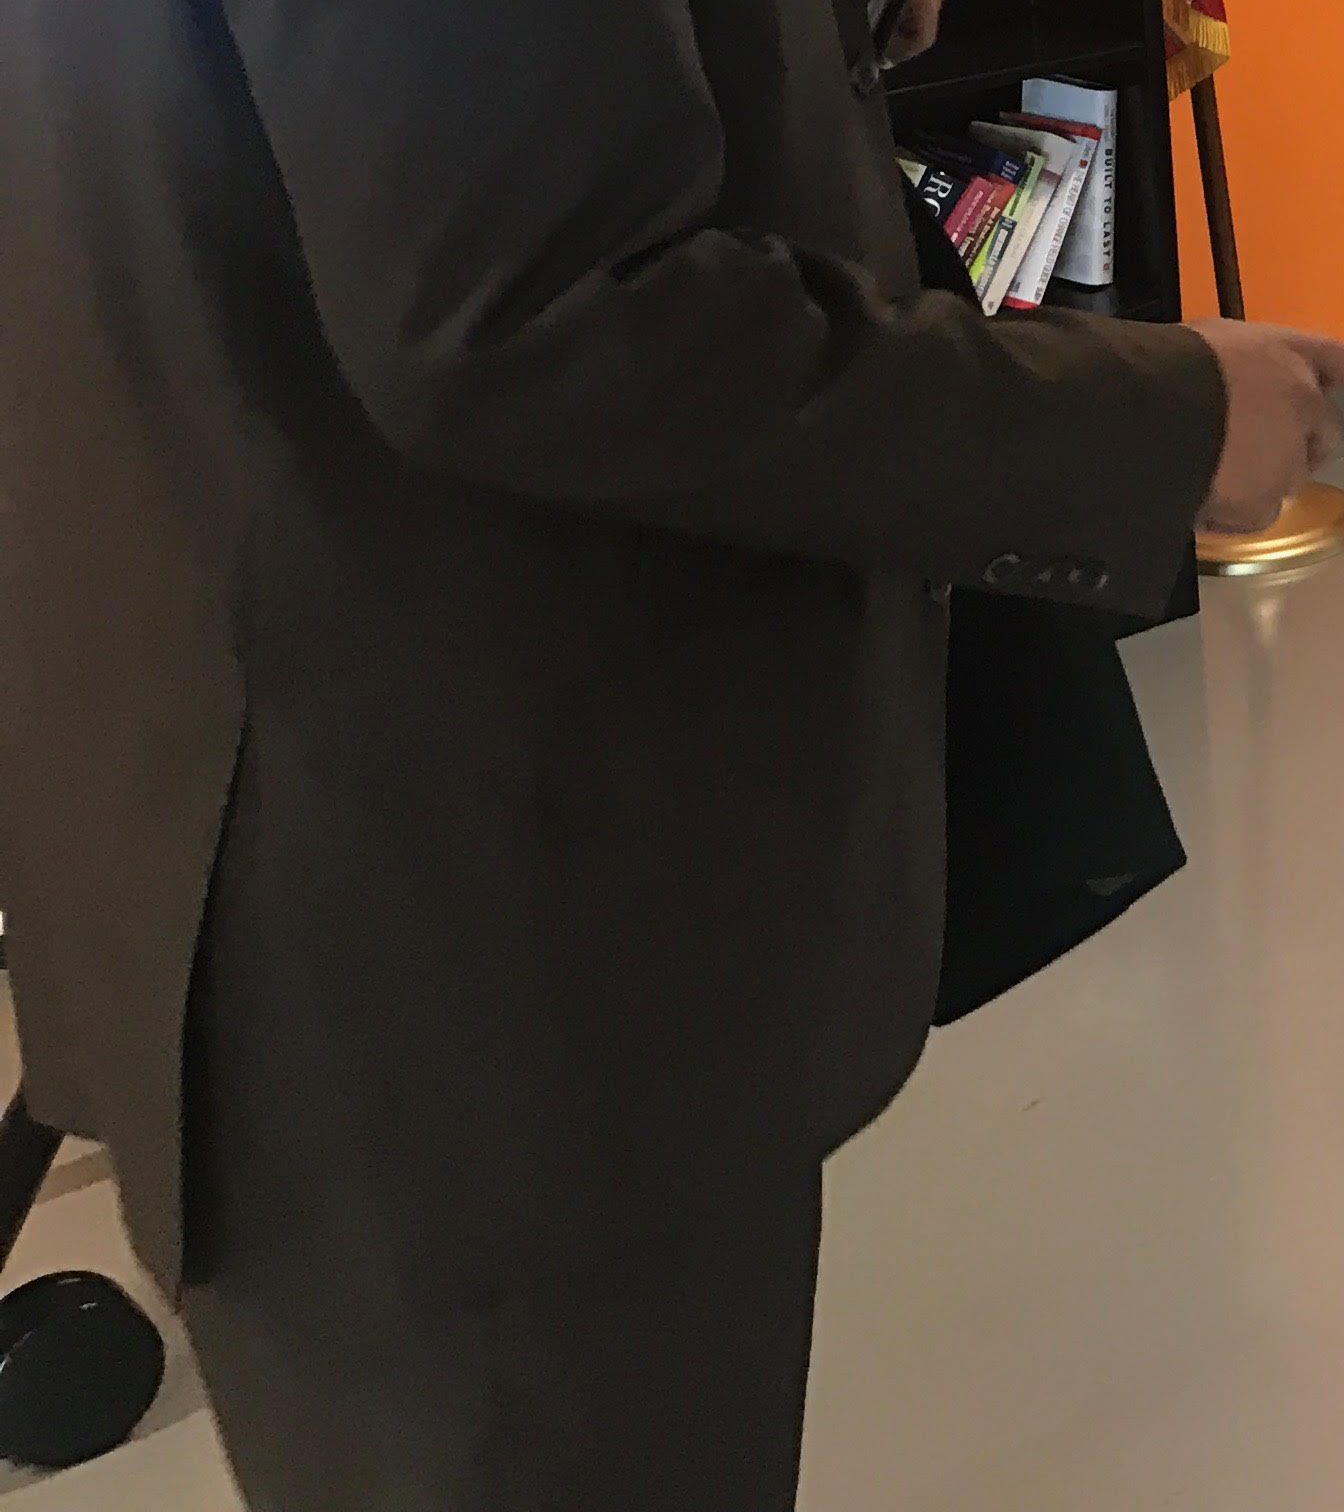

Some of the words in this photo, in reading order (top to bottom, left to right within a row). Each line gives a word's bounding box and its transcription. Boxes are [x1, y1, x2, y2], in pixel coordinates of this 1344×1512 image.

[1104, 148, 1113, 190] BUILT
[1103, 196, 1112, 215] TO
[1102, 221, 1112, 257] LAST
